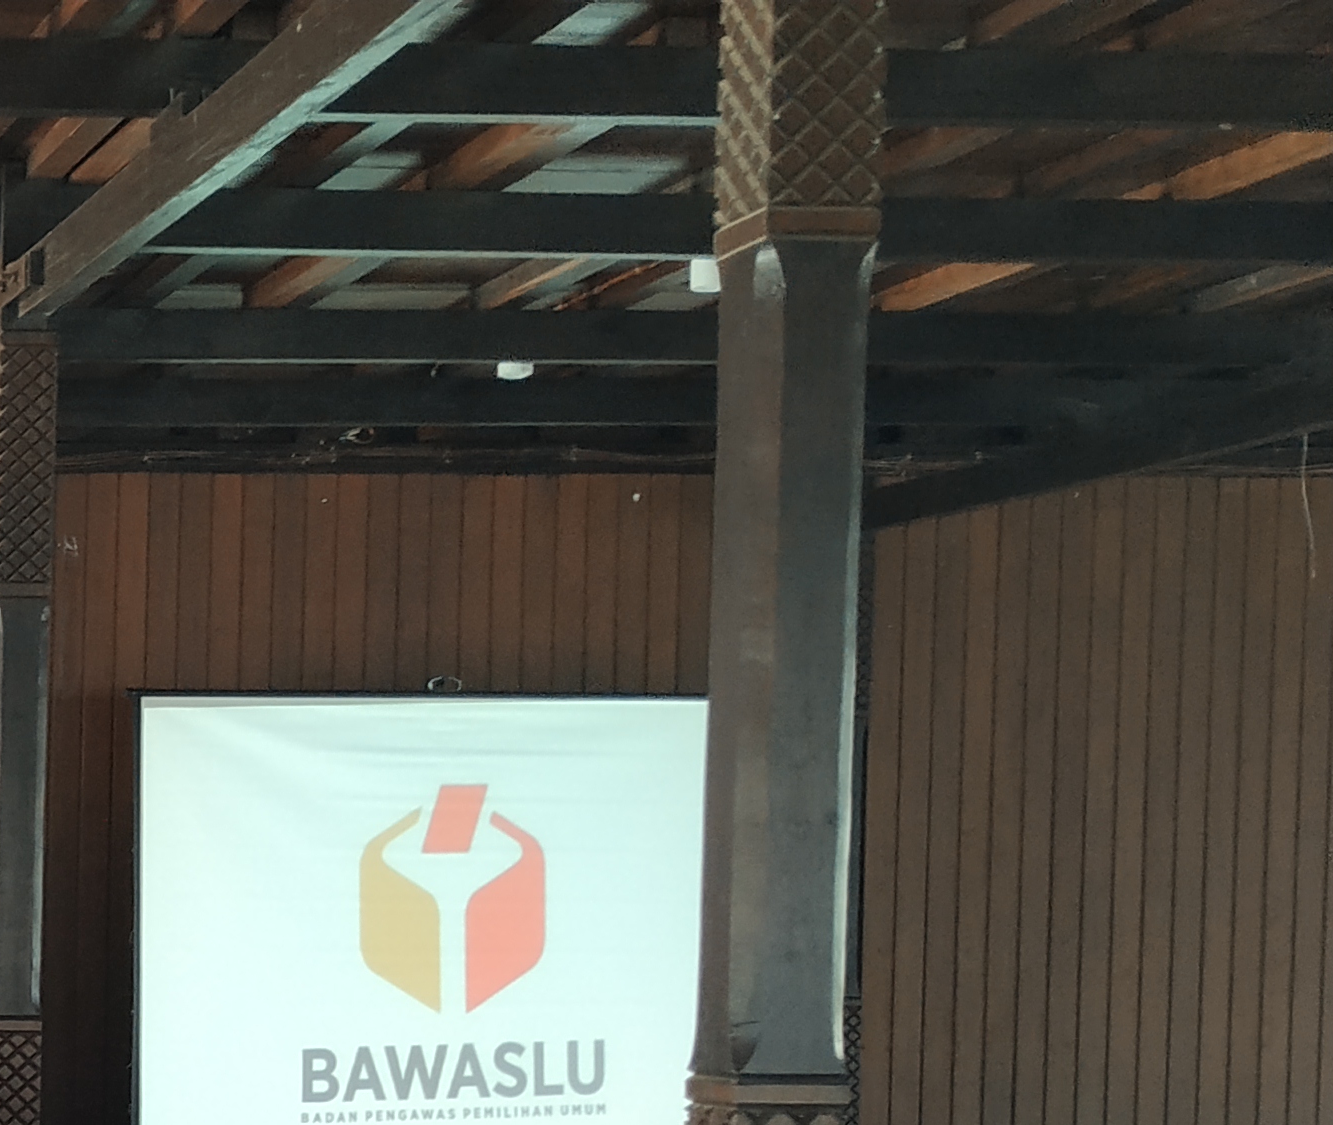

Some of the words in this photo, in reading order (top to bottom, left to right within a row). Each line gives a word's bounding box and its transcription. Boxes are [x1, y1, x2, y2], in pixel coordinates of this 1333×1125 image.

[301, 1039, 606, 1103] BAWASLU
[300, 1110, 359, 1124] BADAN
[365, 1106, 457, 1122] PENGAWAS
[462, 1104, 554, 1120] PEMILIHAN
[559, 1103, 608, 1117] UMUM
